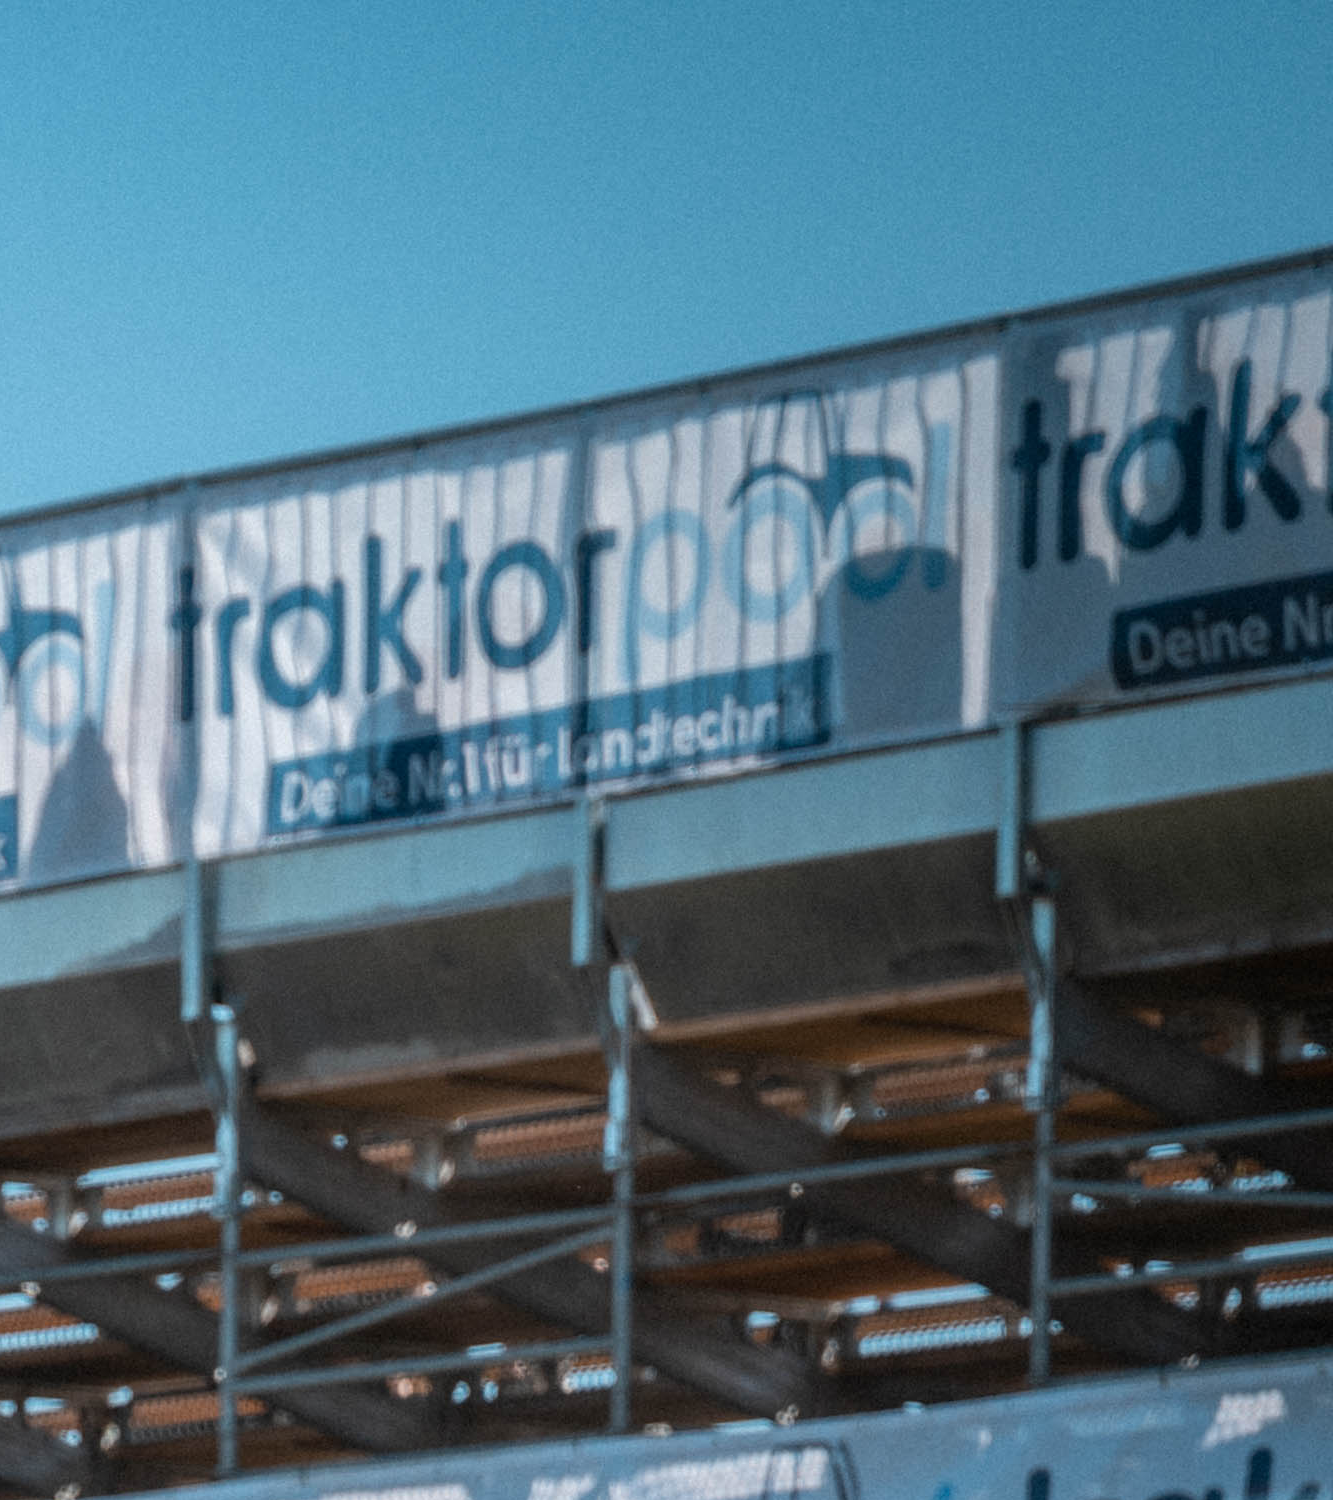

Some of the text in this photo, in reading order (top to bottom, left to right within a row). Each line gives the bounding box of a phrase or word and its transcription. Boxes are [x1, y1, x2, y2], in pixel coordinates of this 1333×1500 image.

[1011, 355, 1333, 571] trak
[170, 419, 952, 723] traktorpool
[1129, 610, 1269, 675] Deine
[280, 761, 400, 824] Deine
[557, 687, 817, 780] Landtechnik
